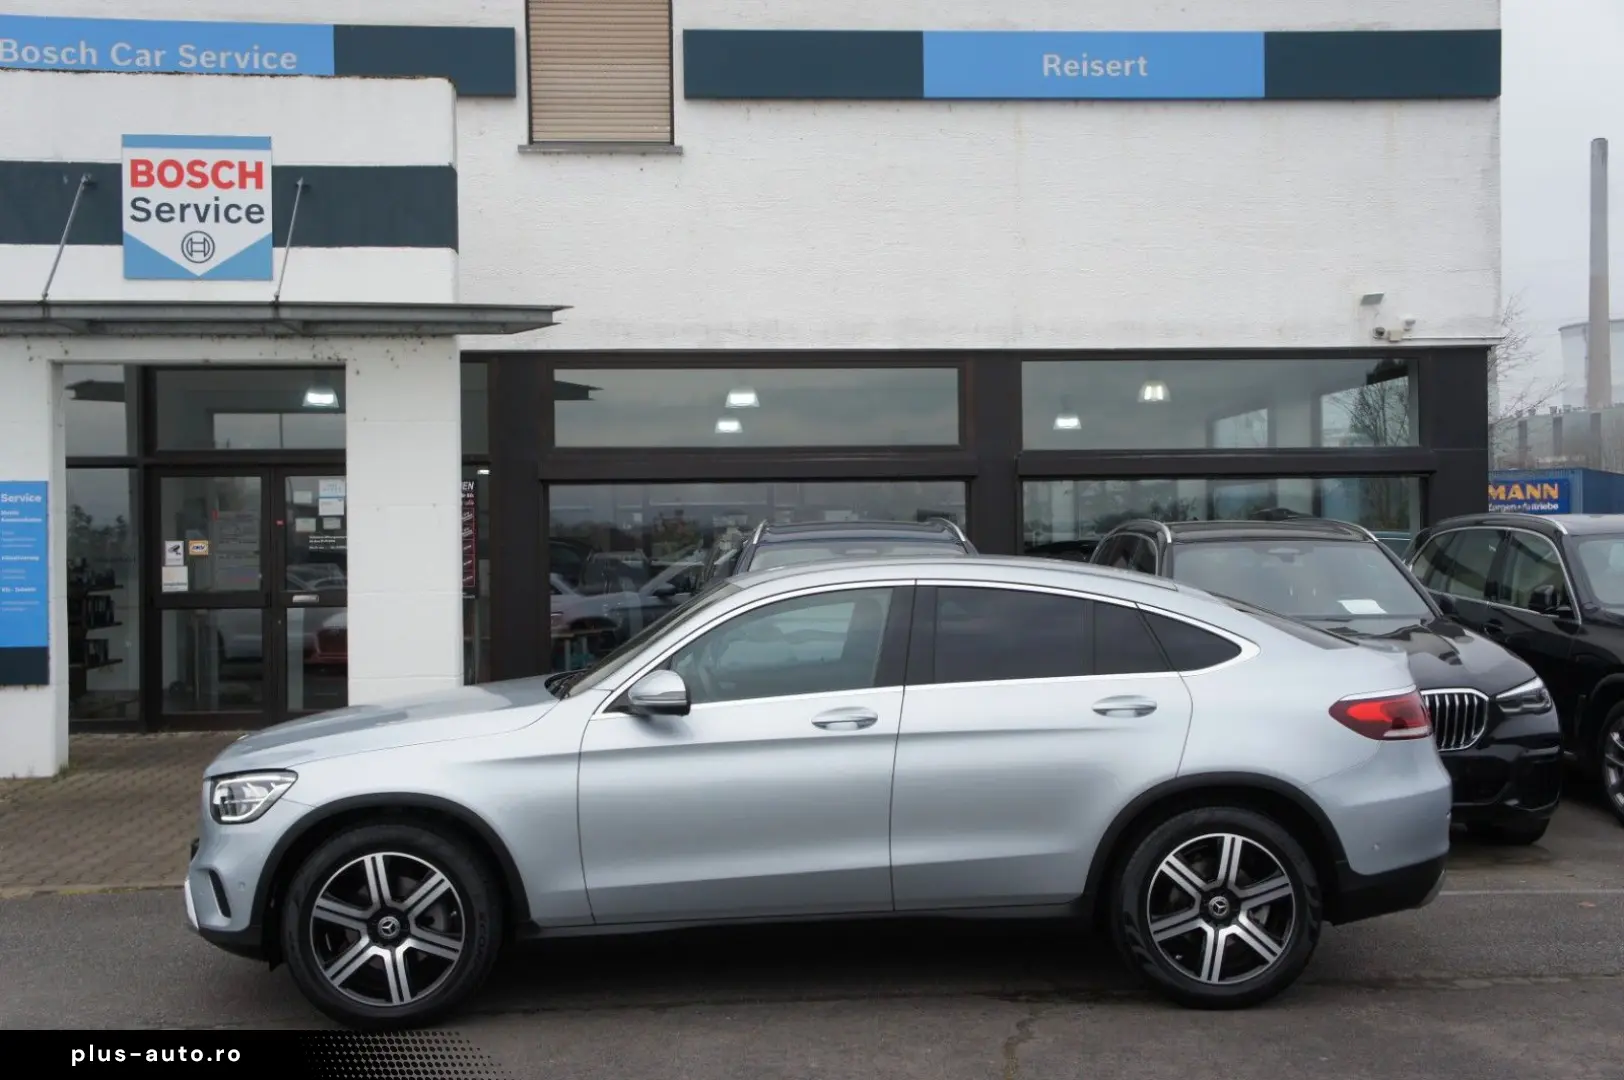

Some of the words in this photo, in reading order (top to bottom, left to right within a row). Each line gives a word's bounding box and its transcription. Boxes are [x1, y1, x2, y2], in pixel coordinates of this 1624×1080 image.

[0, 39, 98, 66] Bosch
[110, 43, 166, 67] Car
[178, 45, 297, 70] Service
[1043, 52, 1148, 77] Reisert
[130, 159, 264, 189] BOSCH
[130, 197, 265, 224] Service
[1, 493, 42, 503] Service
[1488, 483, 1559, 500] MANN
